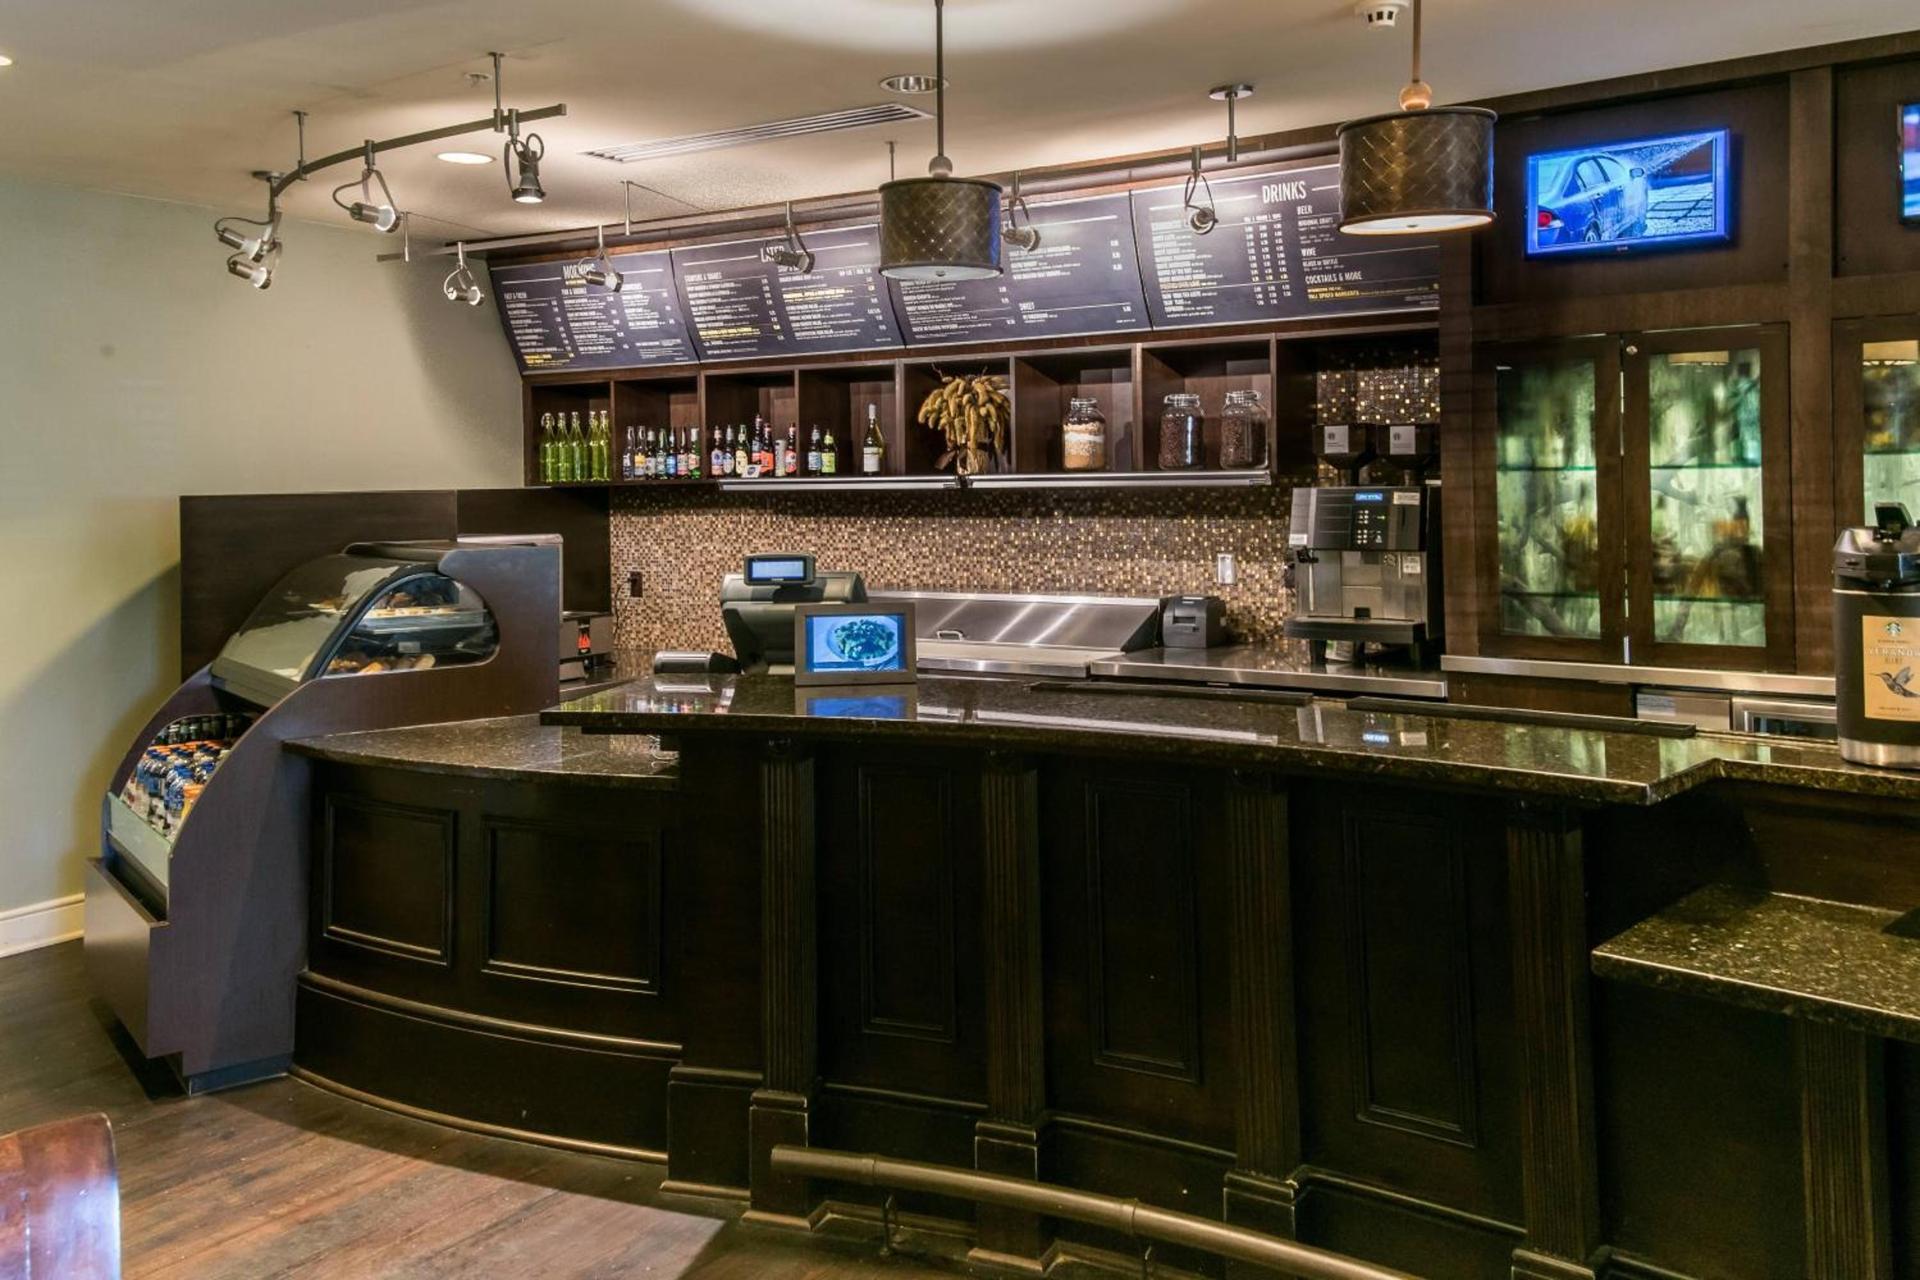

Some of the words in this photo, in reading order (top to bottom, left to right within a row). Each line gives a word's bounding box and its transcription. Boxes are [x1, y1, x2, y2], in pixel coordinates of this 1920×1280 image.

[1262, 181, 1307, 203] DRINKS
[1301, 247, 1316, 256] WINE
[1305, 273, 1337, 284] COCKTAILS
[1345, 271, 1362, 280] MORE
